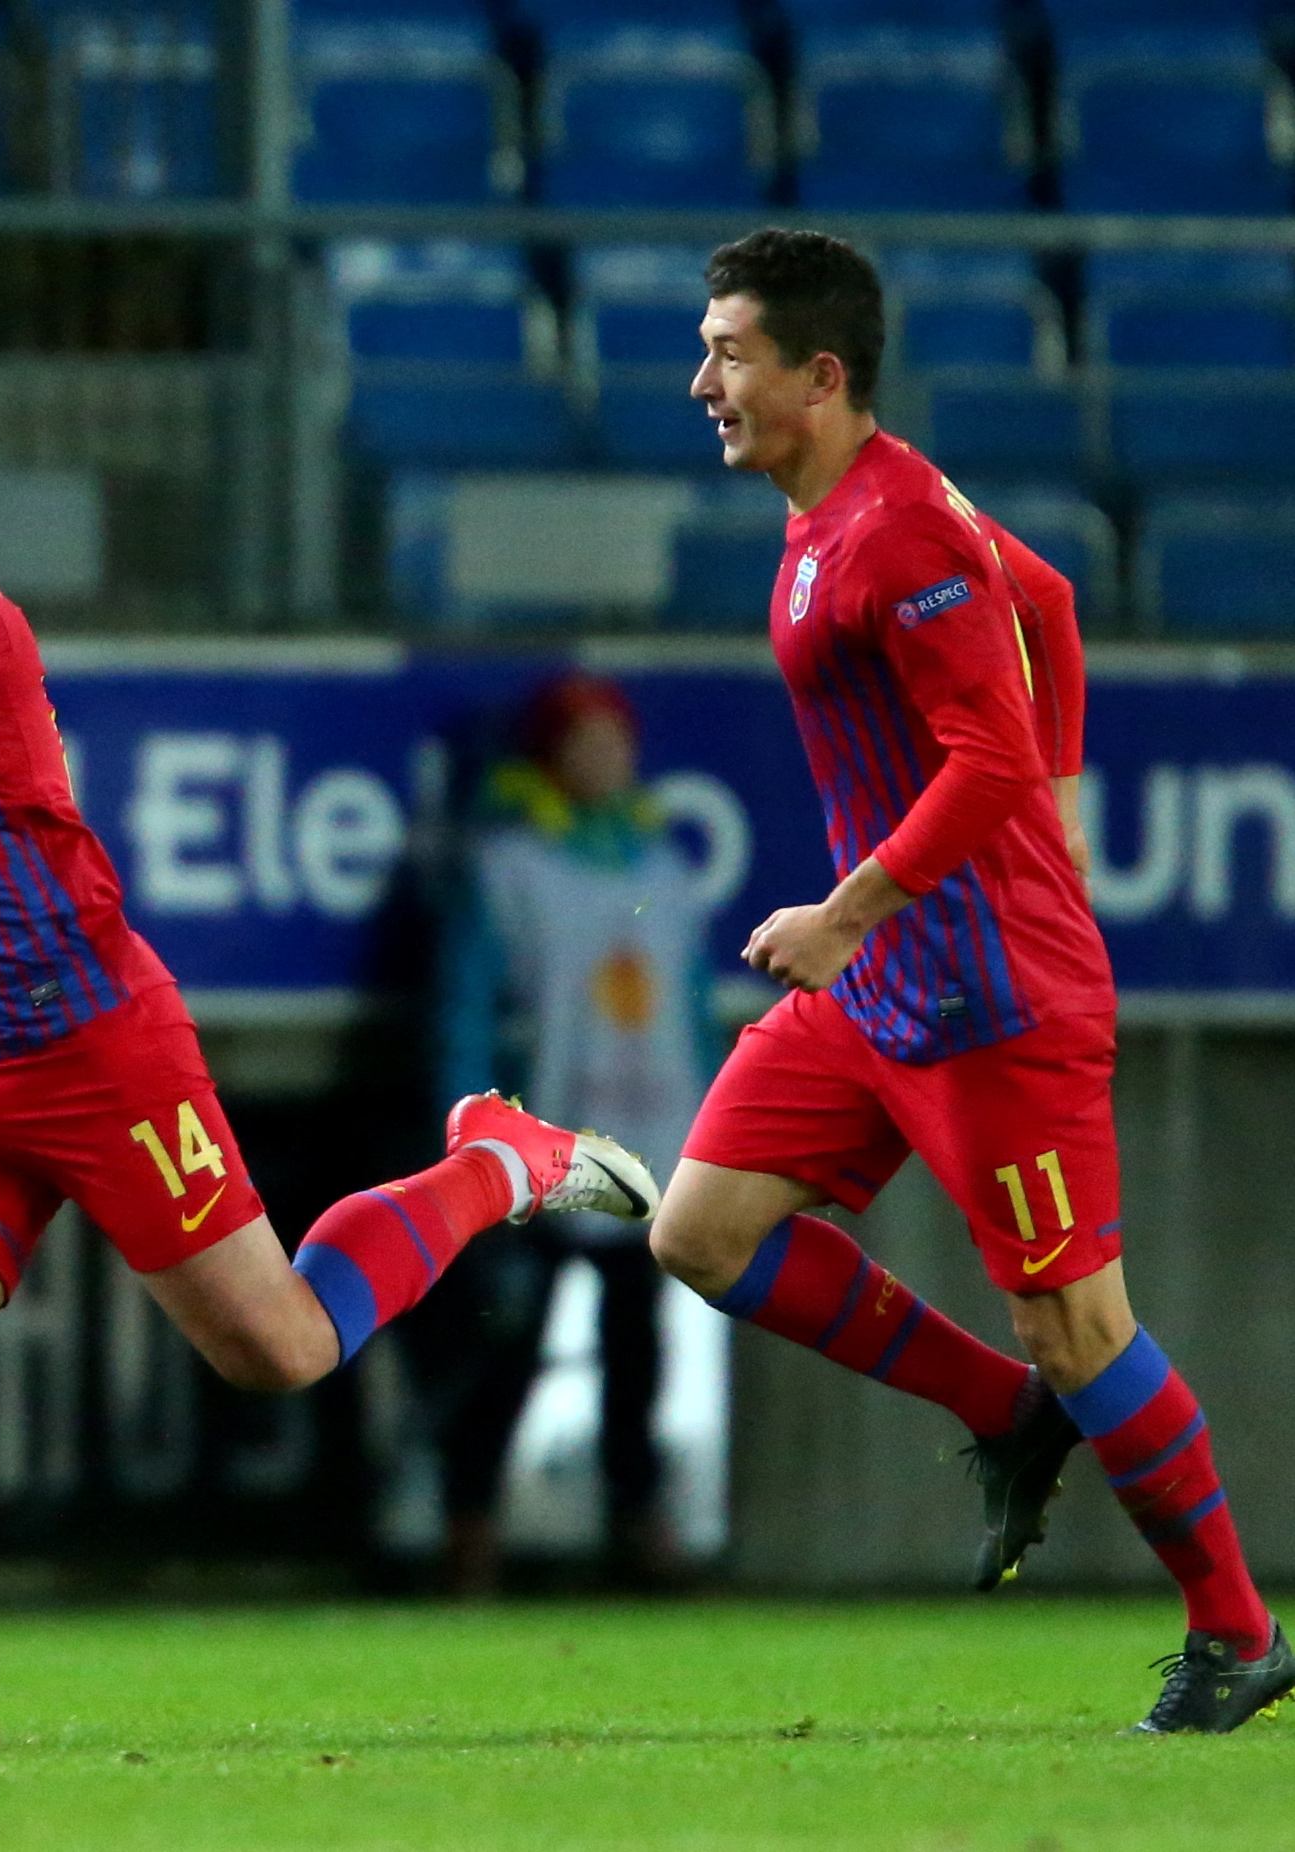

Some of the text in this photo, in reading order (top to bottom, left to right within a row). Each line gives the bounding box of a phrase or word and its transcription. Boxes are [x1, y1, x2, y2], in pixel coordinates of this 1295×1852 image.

[917, 580, 970, 613] RESPECT
[128, 1098, 228, 1200] 14
[994, 1148, 1076, 1242] 11
